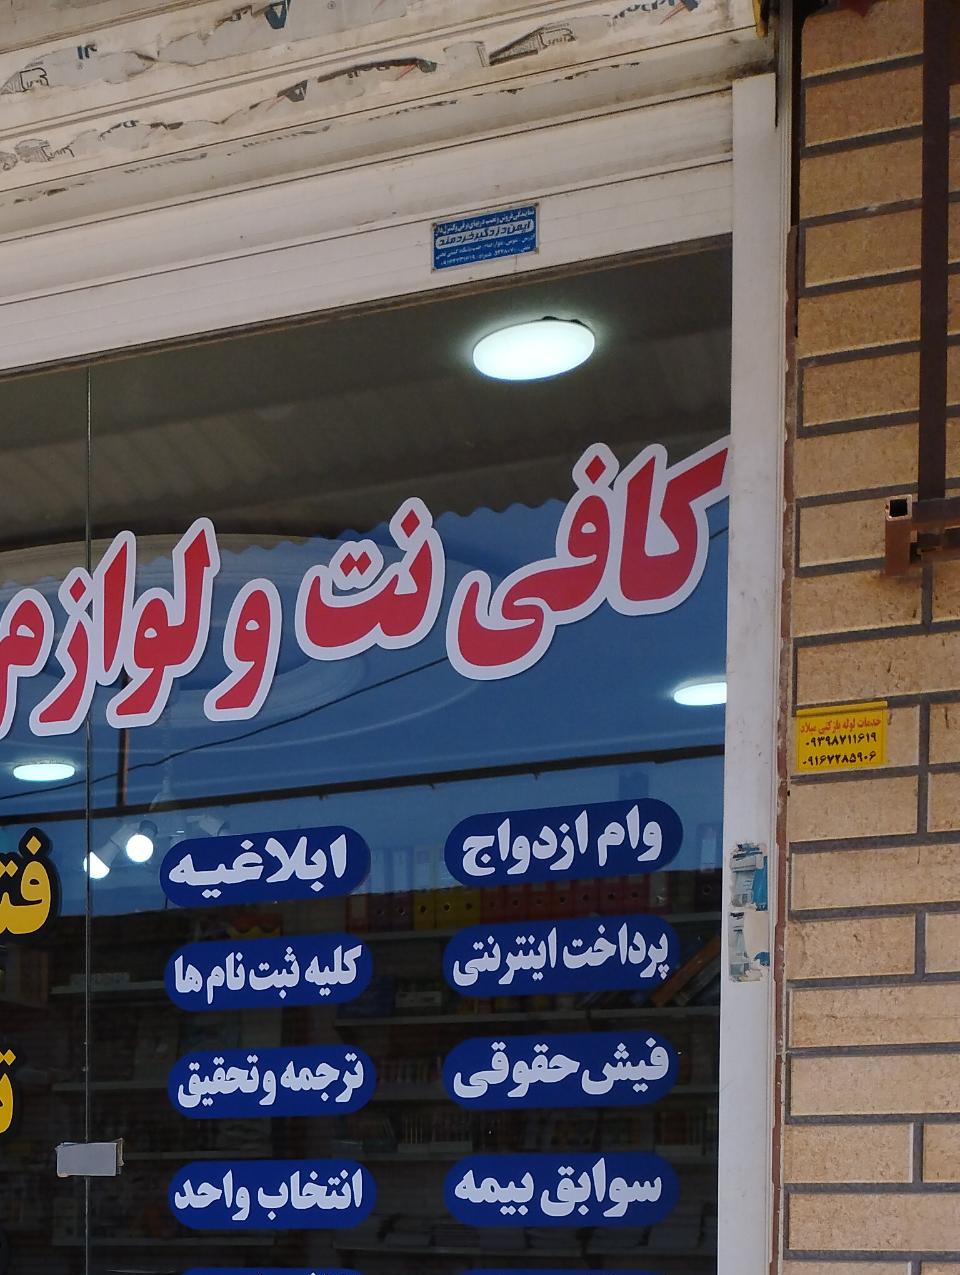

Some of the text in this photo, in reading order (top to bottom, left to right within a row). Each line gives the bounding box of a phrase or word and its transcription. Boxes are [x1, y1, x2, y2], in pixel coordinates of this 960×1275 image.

[297, 499, 444, 659] نت
[447, 440, 730, 678] کافی
[205, 580, 281, 720] و
[168, 834, 347, 899] ابلاغیه
[461, 805, 663, 877] وام ازدواج
[174, 944, 363, 1004] کلیه ثبت نام ها
[452, 922, 670, 987] پرداخت اینترنتی
[281, 1053, 364, 1103] ترجمه
[453, 1037, 670, 1098] فیش حقوقی
[174, 1168, 363, 1222] انتخاب واحد
[454, 1157, 662, 1218] سوابق بیمه
